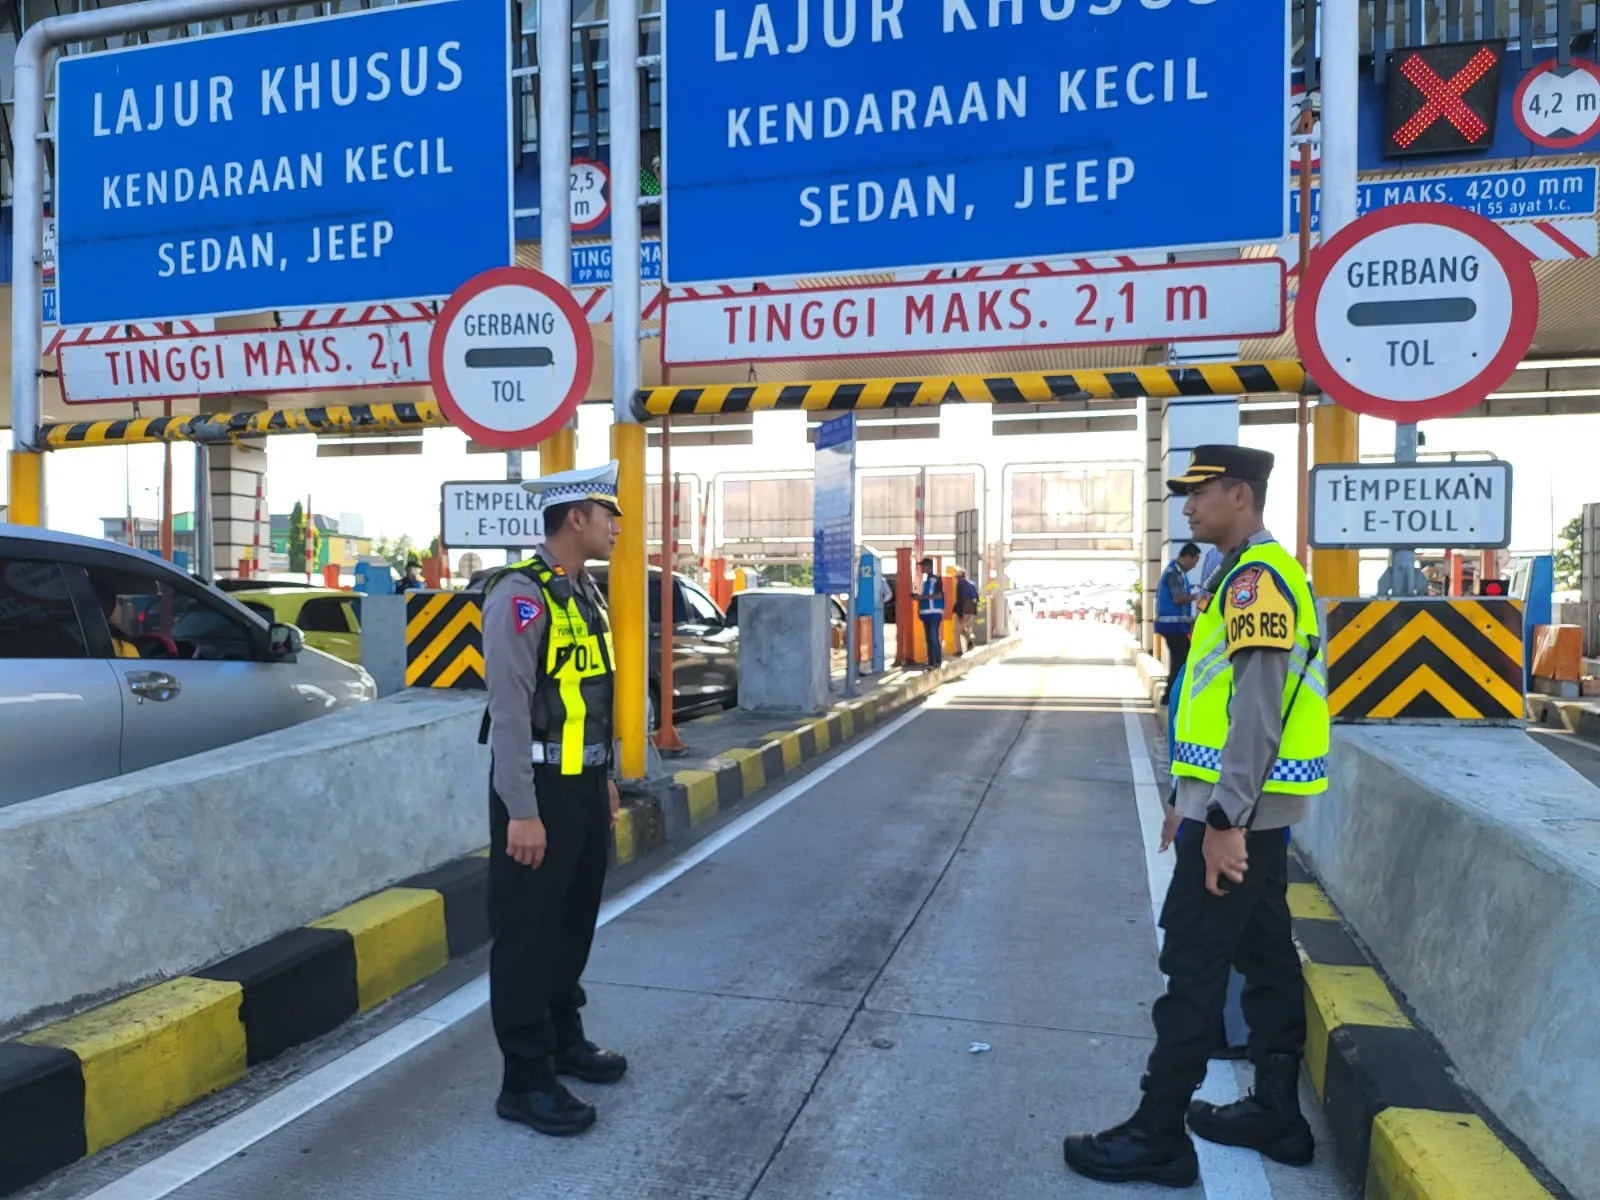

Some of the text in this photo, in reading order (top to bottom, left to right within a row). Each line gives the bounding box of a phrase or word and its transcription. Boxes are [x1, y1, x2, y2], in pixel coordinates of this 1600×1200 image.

[716, 0, 903, 61] LAJUR
[94, 41, 461, 136] LAJUR KHUSUS
[728, 58, 1207, 147] KENDARAAN KECIL
[1529, 93, 1596, 118] 4,2 m
[104, 138, 452, 209] KENDARAAN KECIL
[800, 157, 1134, 227] SEDAN, JEEP
[1384, 183, 1453, 206] MAKS.
[1466, 177, 1526, 200] 4200
[1539, 176, 1583, 196] mm
[575, 201, 589, 216] m
[1487, 201, 1503, 215] 55
[1510, 200, 1541, 217] ayat
[159, 221, 393, 276] SEDAN, JEEP
[572, 249, 611, 269] TING
[1348, 256, 1478, 288] GERBANG
[464, 312, 554, 336] GERBANG
[724, 283, 1206, 345] TINGGI MAKS. 2,1 m
[105, 332, 413, 385] TINGGI MAKS. 2,1
[1386, 340, 1434, 366] TOL
[492, 381, 525, 402] TOL
[454, 492, 542, 511] TEMPELK
[1328, 476, 1493, 502] TEMPELKAN
[479, 518, 541, 536] E-TOLL
[1364, 510, 1457, 531] E-TOLL
[1231, 612, 1287, 642] OPS RES
[556, 645, 599, 672] POL
